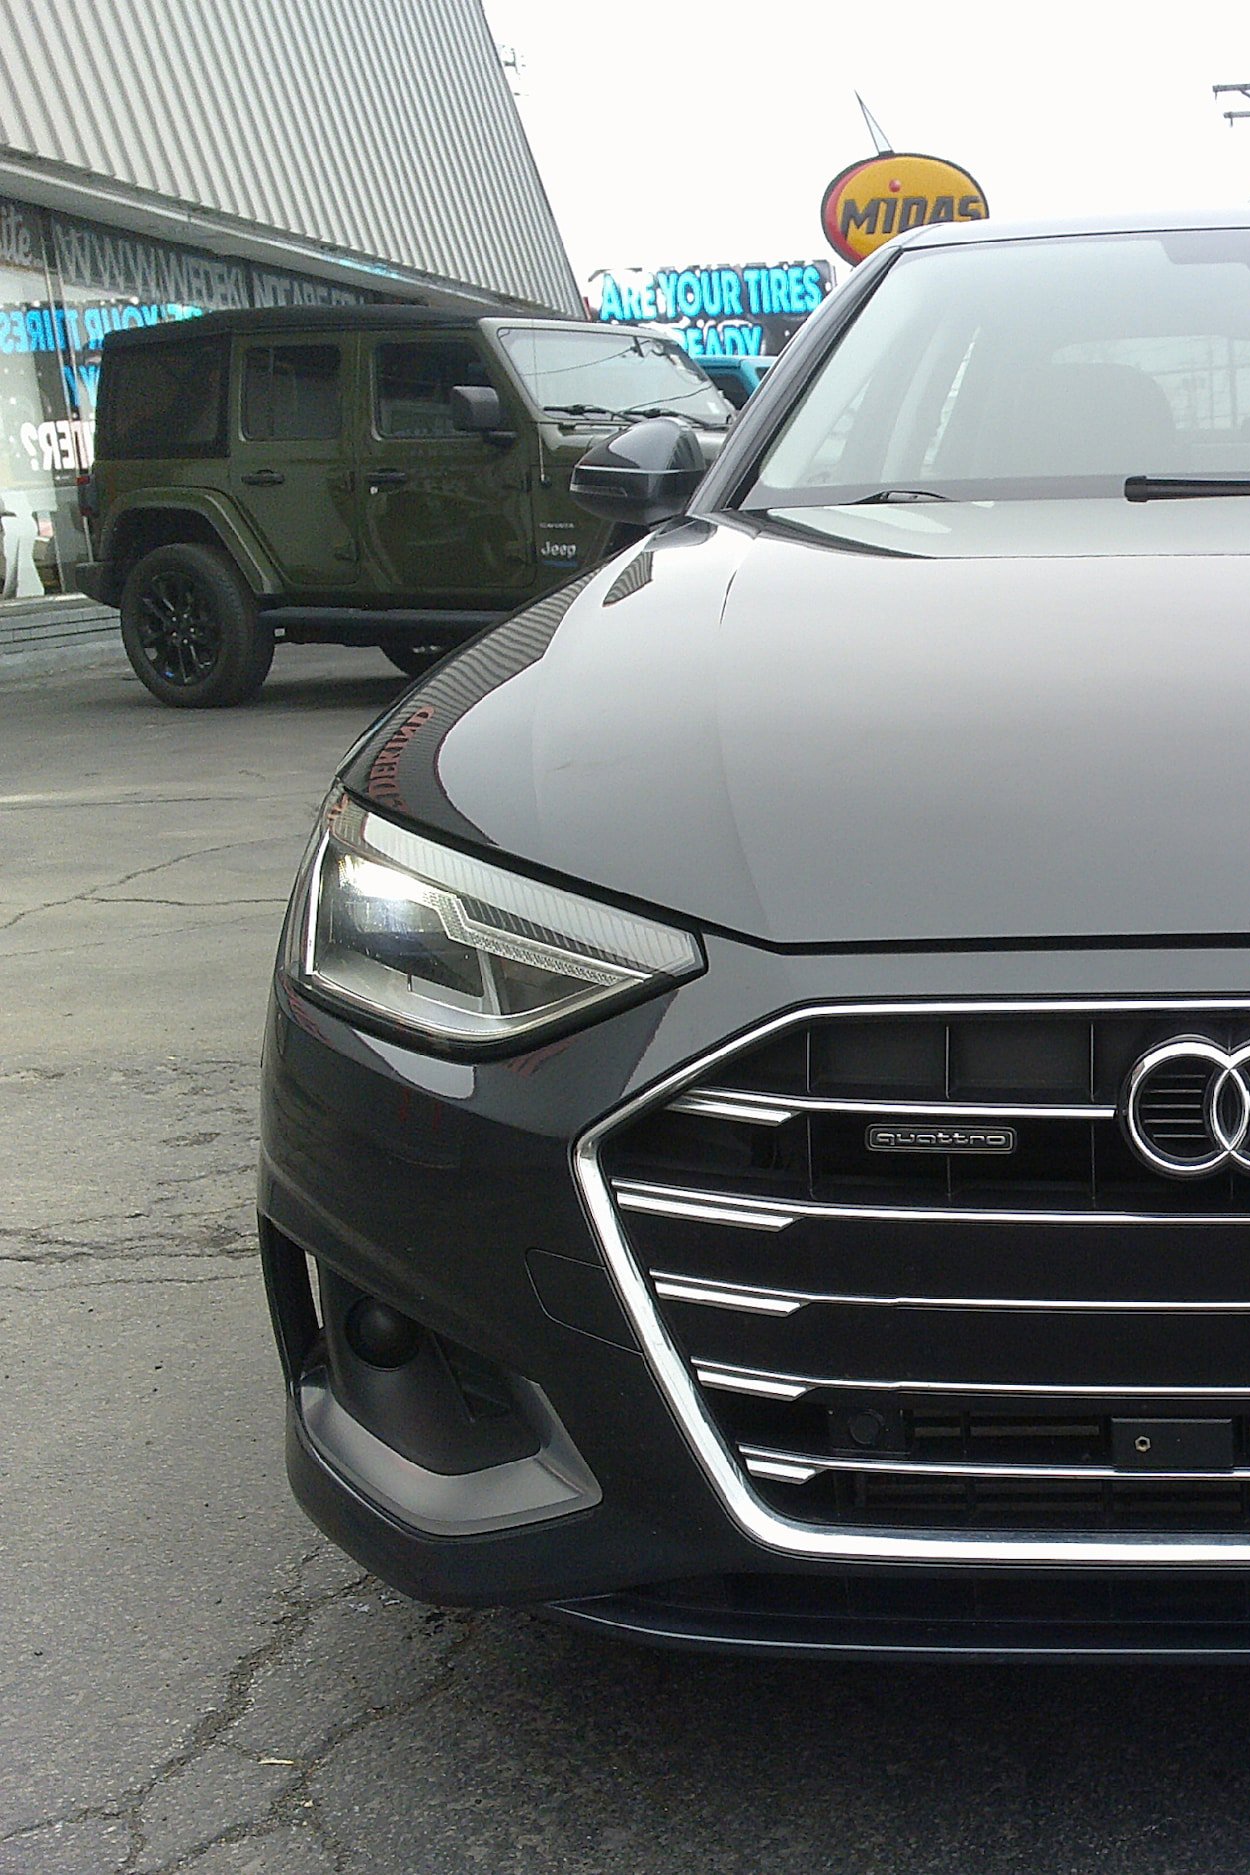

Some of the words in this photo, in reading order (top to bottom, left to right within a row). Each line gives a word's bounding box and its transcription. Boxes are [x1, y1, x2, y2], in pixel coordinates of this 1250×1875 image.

[840, 195, 984, 240] MIDAS
[600, 273, 657, 321] ARE
[657, 268, 744, 319] YOUR
[743, 264, 823, 315] TIRES
[541, 541, 577, 559] Jeep
[875, 1132, 1006, 1146] quattro
